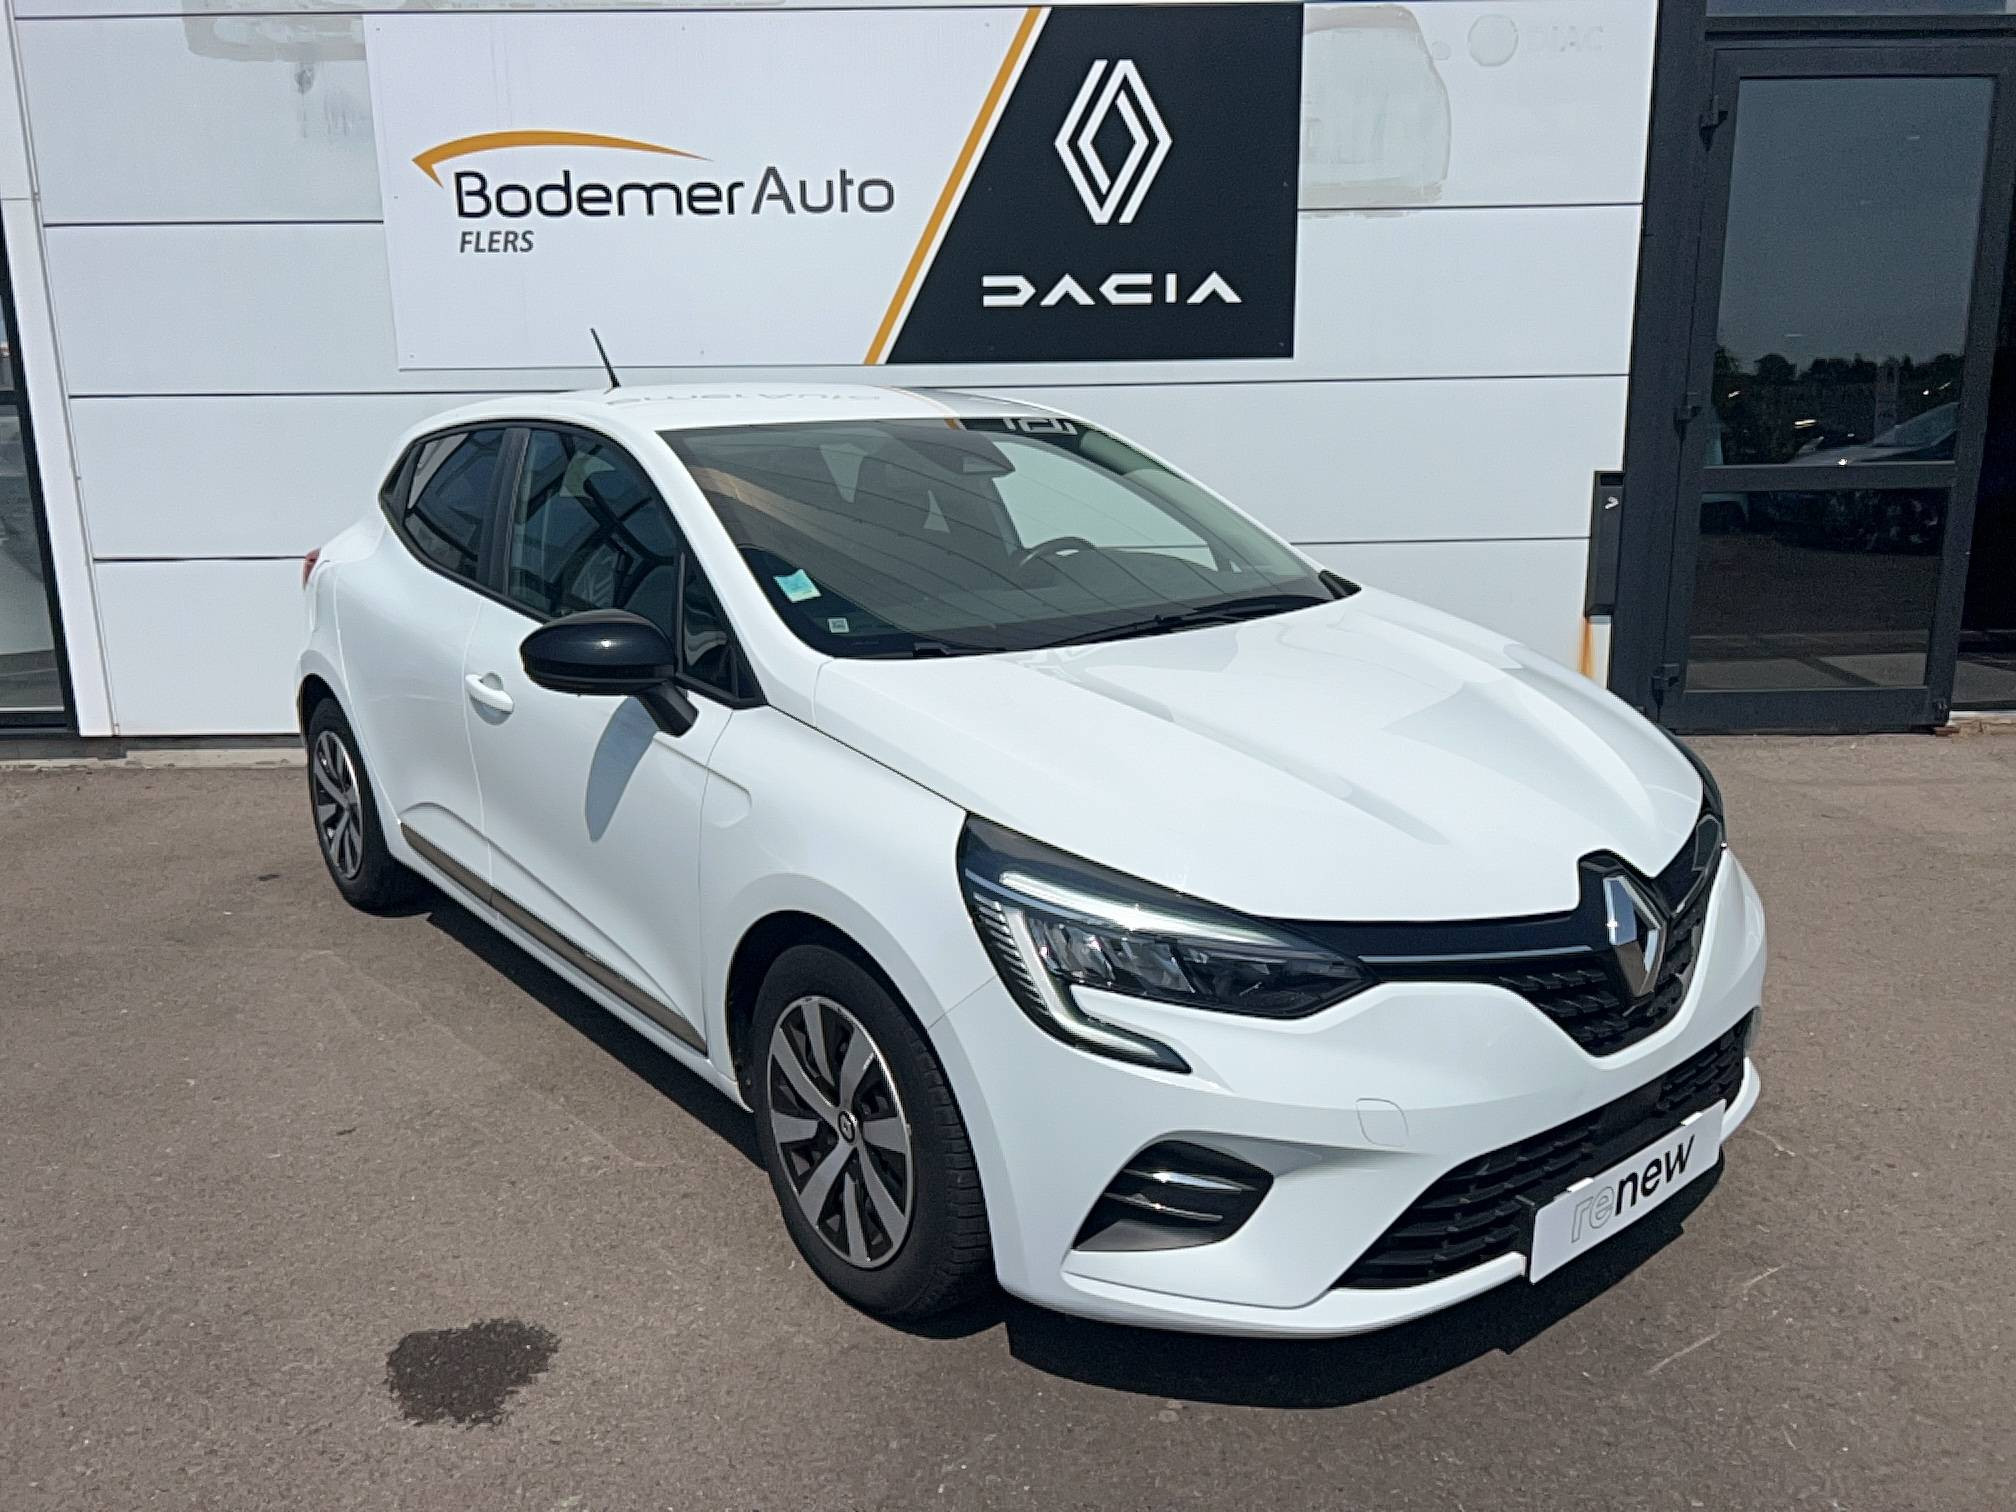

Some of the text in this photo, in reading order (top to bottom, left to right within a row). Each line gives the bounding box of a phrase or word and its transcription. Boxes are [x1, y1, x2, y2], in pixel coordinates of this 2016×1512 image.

[459, 230, 535, 254] FLERS
[982, 271, 1242, 307] DACIA
[1571, 1134, 1696, 1244] renew
